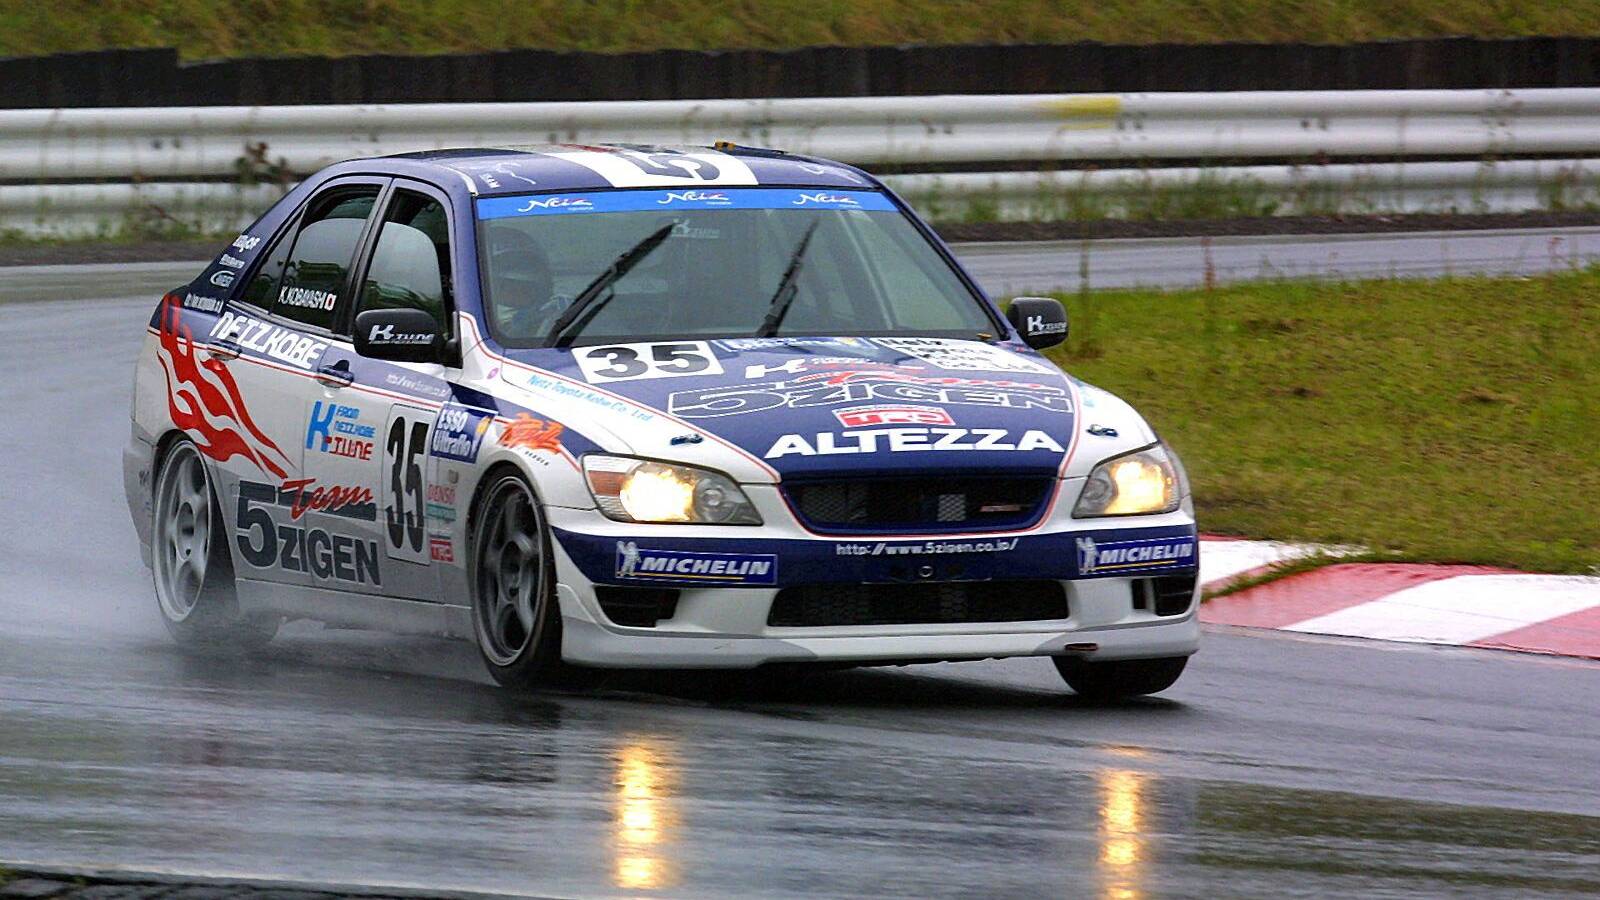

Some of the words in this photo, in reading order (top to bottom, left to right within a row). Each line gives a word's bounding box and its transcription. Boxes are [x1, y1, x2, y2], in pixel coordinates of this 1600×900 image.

[586, 344, 711, 378] 35
[437, 408, 469, 433] ESSO
[763, 428, 1065, 459] ALTEZZA
[281, 478, 374, 521] Team
[385, 416, 429, 553] 35
[640, 556, 771, 576] MICHELIN
[1100, 542, 1193, 565] MICHELIN
